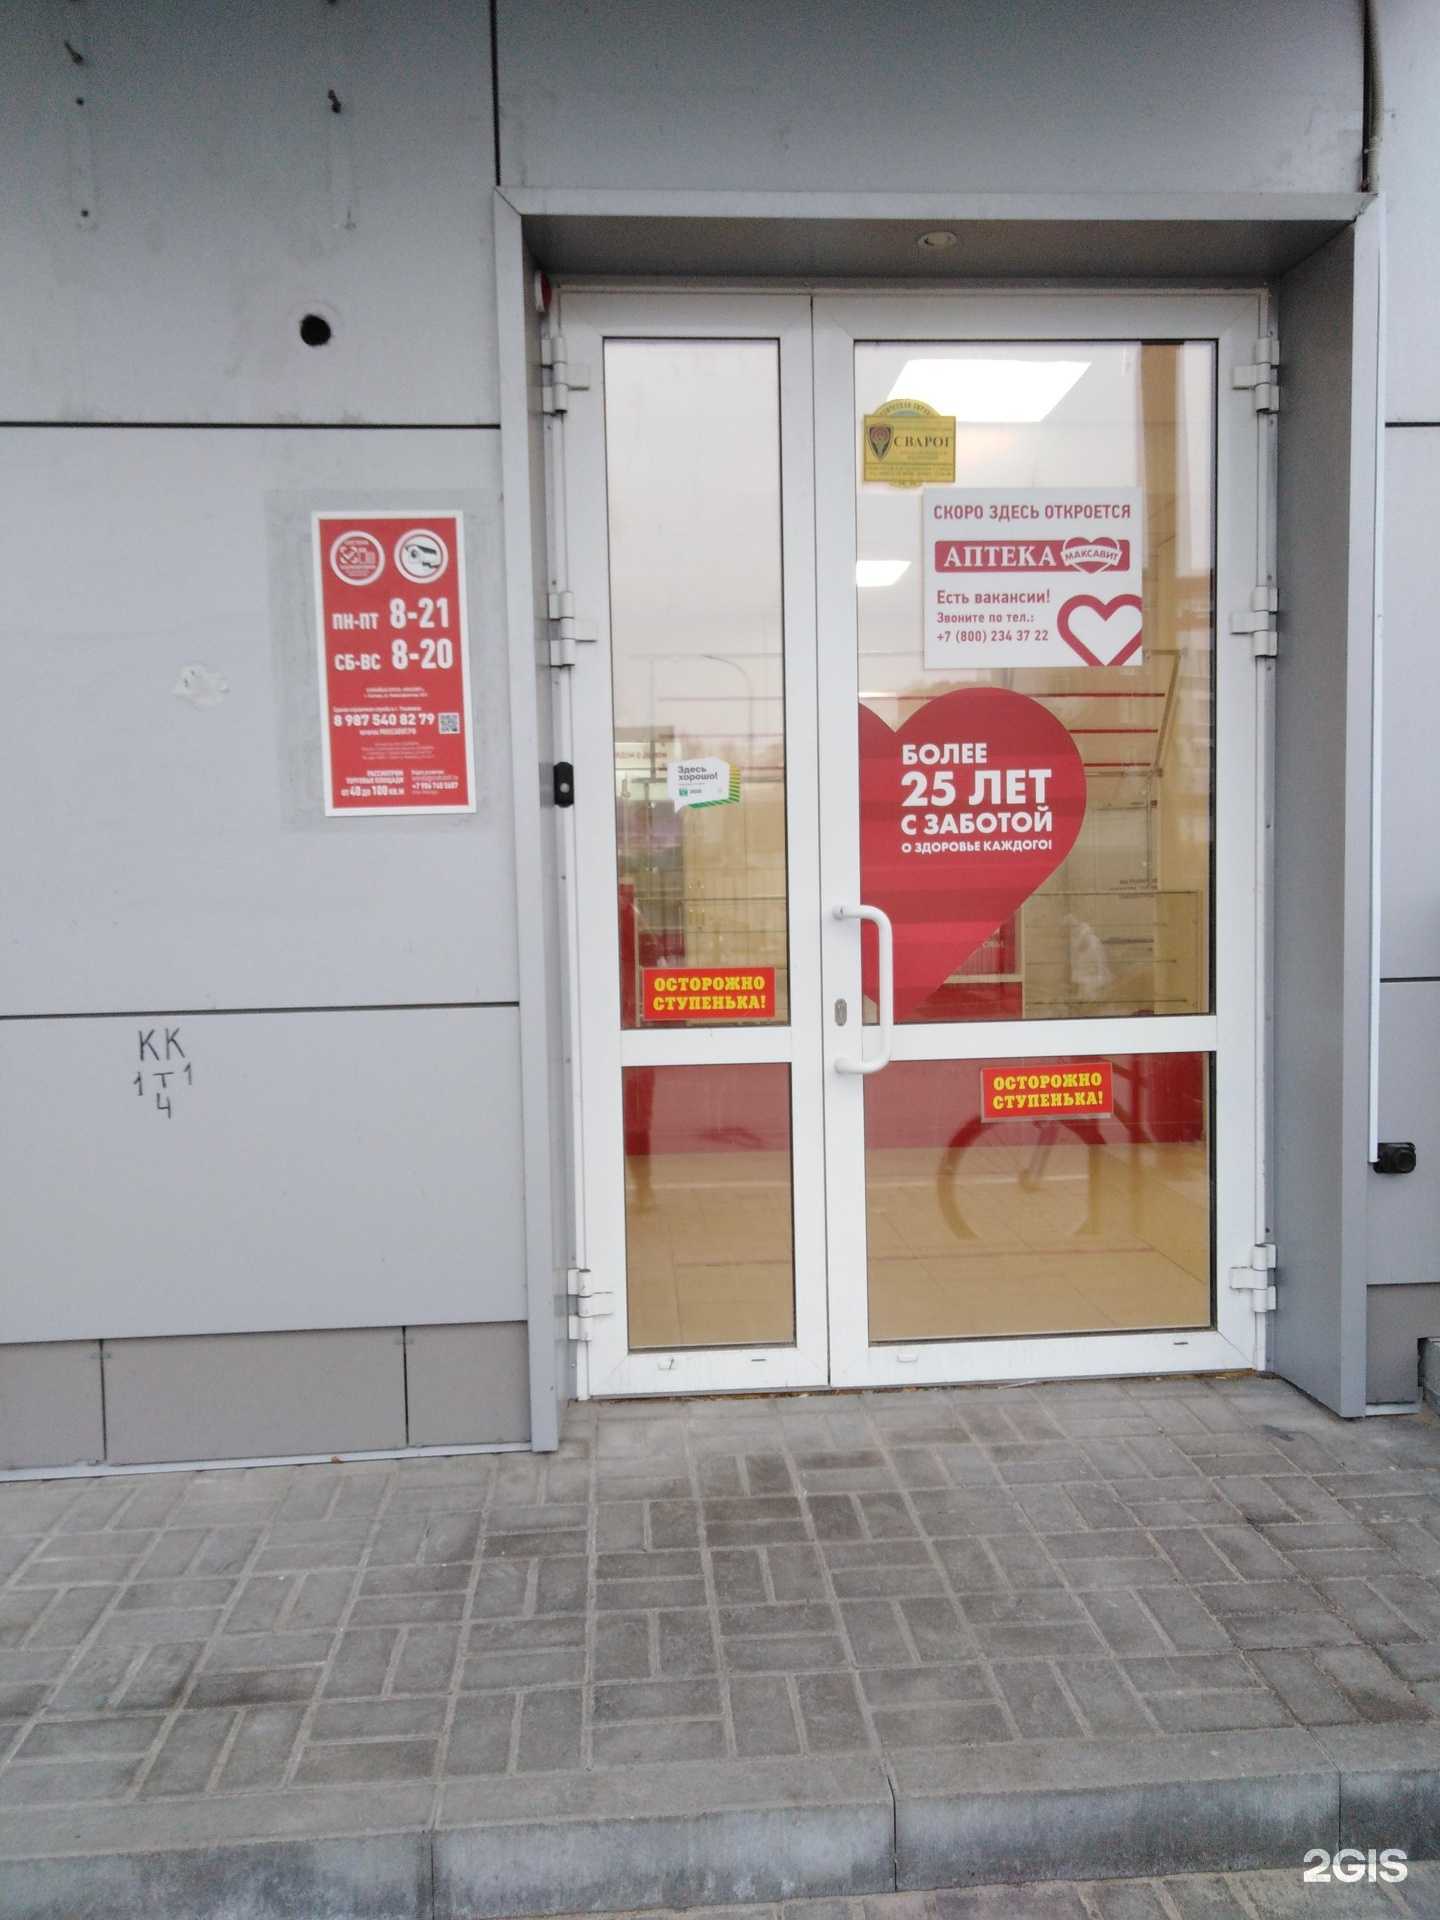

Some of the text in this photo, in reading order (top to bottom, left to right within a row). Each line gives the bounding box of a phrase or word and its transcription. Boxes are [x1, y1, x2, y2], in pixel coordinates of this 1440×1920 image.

[934, 504, 1131, 522] СКОРО ЗДЕСЬ ОТКРОЕТСЯ
[943, 546, 1057, 568] АПТЕКА
[1064, 549, 1119, 562] МАКСАВИТ
[936, 588, 1051, 605] Есть вакансии!
[332, 597, 449, 630] ПН-ПТ 8-21
[936, 612, 1035, 624] Звоните по тел.:
[936, 630, 1049, 644] +7 (800) 234 37 22
[334, 638, 453, 671] СБ-ВС 8-20
[333, 714, 342, 727] 8
[902, 743, 987, 765] БОЛЕЕ
[678, 765, 707, 775] Здесь
[678, 772, 718, 784] хорошо!
[901, 769, 1052, 807] 25 ЛЕТ
[901, 805, 1052, 835] С ЗАБОТОЙ
[902, 839, 1052, 855] О ЗДОРОВЬЕ КАЖДОГО!
[654, 976, 766, 992] ОСТОРОЖНО
[653, 995, 767, 1011] СТУПЕНЬКА!
[993, 1072, 1103, 1091] ОСТОРОЖНО
[992, 1091, 1104, 1110] СТУПЕНЬКА!
